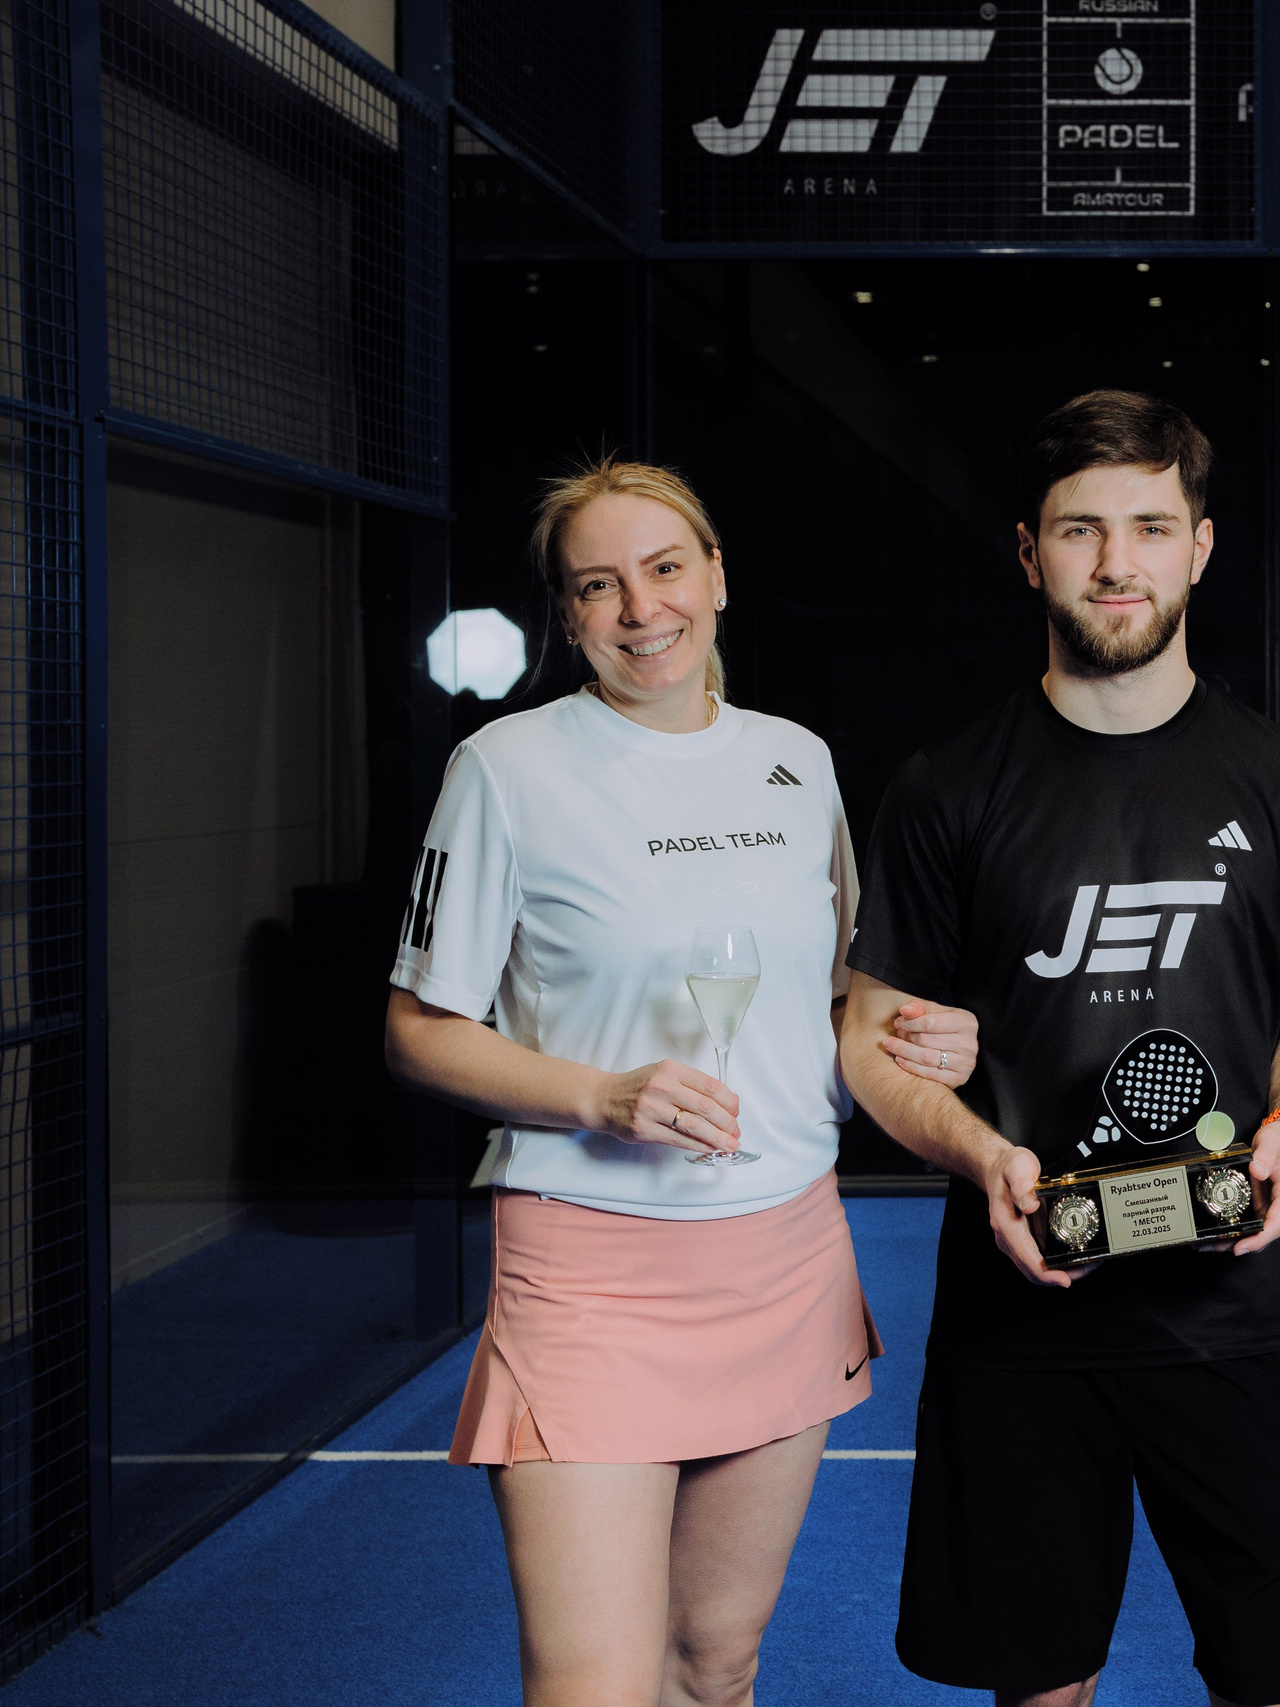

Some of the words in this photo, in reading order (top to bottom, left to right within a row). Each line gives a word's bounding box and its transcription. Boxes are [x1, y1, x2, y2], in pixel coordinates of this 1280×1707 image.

[692, 29, 996, 155] JET
[1058, 125, 1180, 148] PADEL
[783, 177, 878, 196] ARENA
[647, 836, 725, 856] PADEL
[725, 831, 787, 849] TEAM
[1024, 881, 1227, 979] JET
[1089, 987, 1155, 1004] ARENA
[1110, 1179, 1152, 1195] Ryabtsev
[1153, 1176, 1178, 1190] Open
[1124, 1194, 1169, 1208] Смешанный
[1122, 1207, 1150, 1219] парный
[1150, 1203, 1176, 1216] разряд
[1133, 1219, 1138, 1227] 1
[1138, 1214, 1167, 1226] МЕСТО
[1131, 1224, 1172, 1238] 22.03.2025
